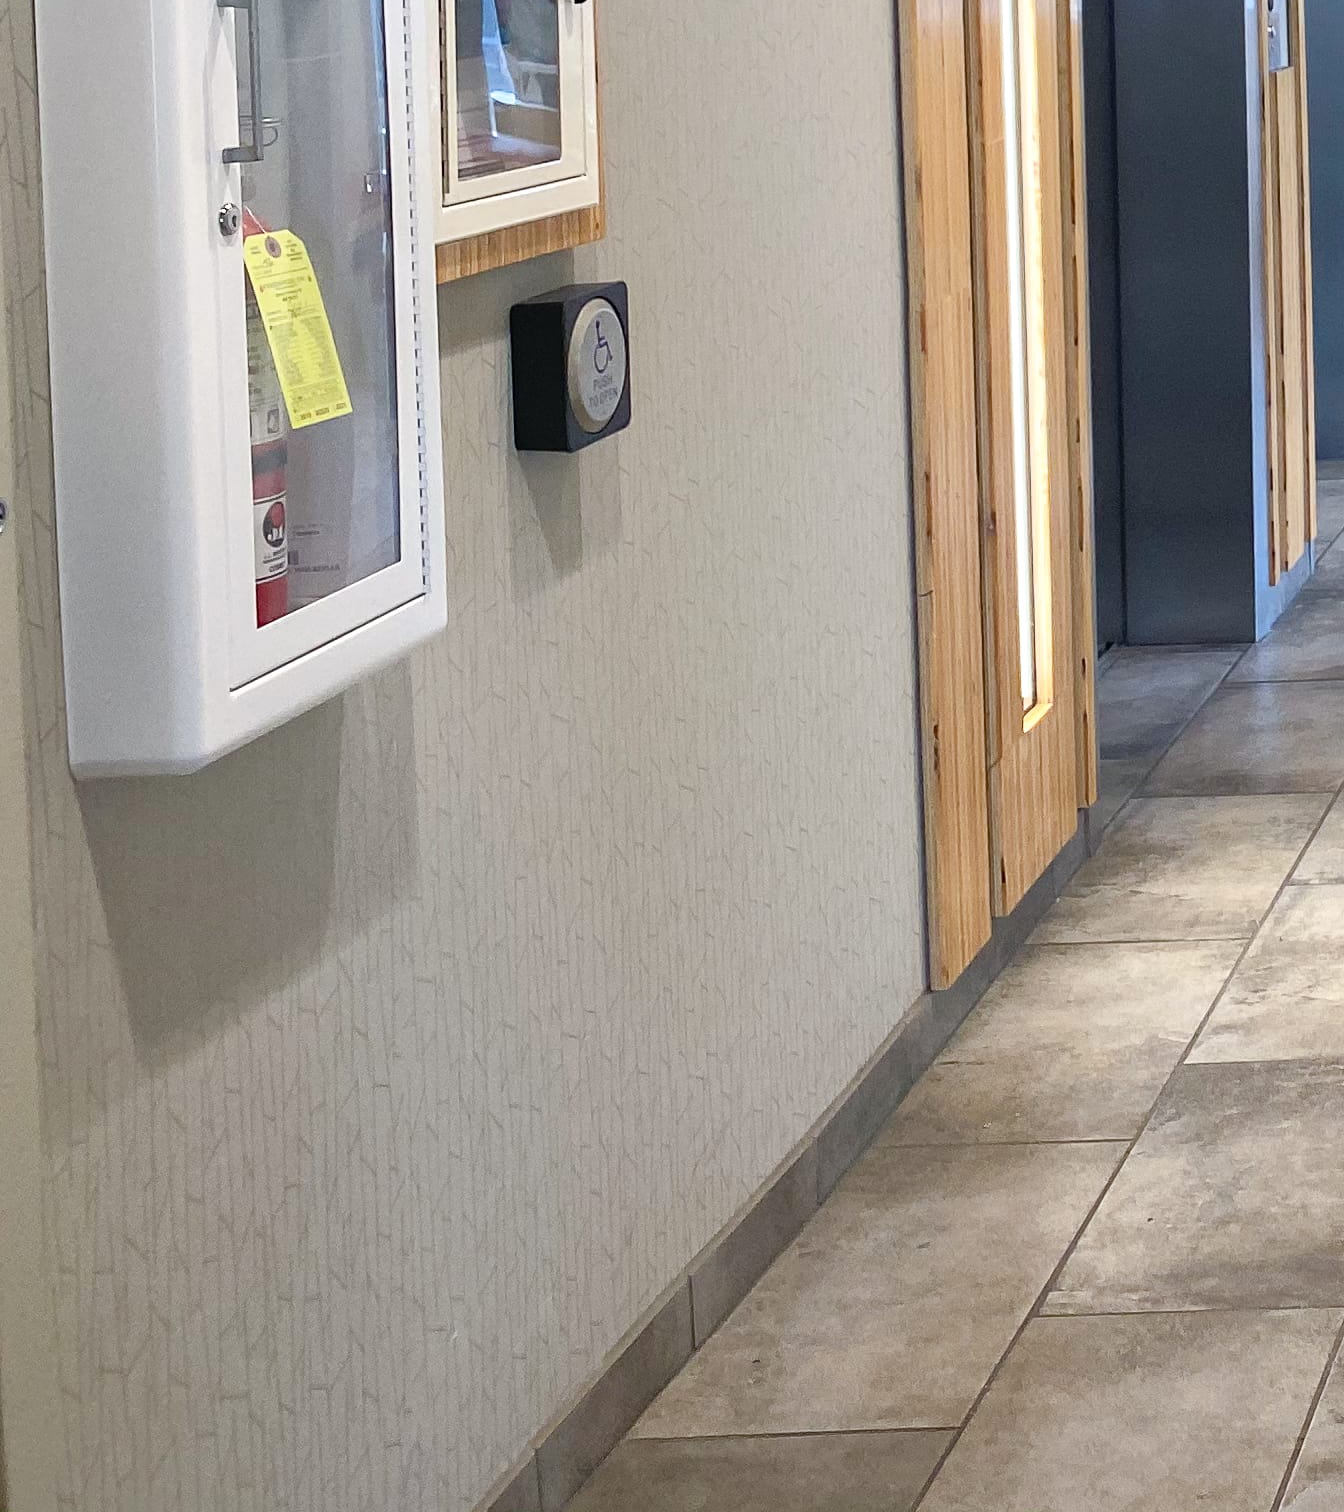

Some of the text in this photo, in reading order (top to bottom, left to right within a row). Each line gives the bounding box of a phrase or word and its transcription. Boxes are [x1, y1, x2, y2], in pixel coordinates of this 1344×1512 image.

[593, 374, 613, 392] PUSH
[588, 387, 619, 408] TO OPEN
